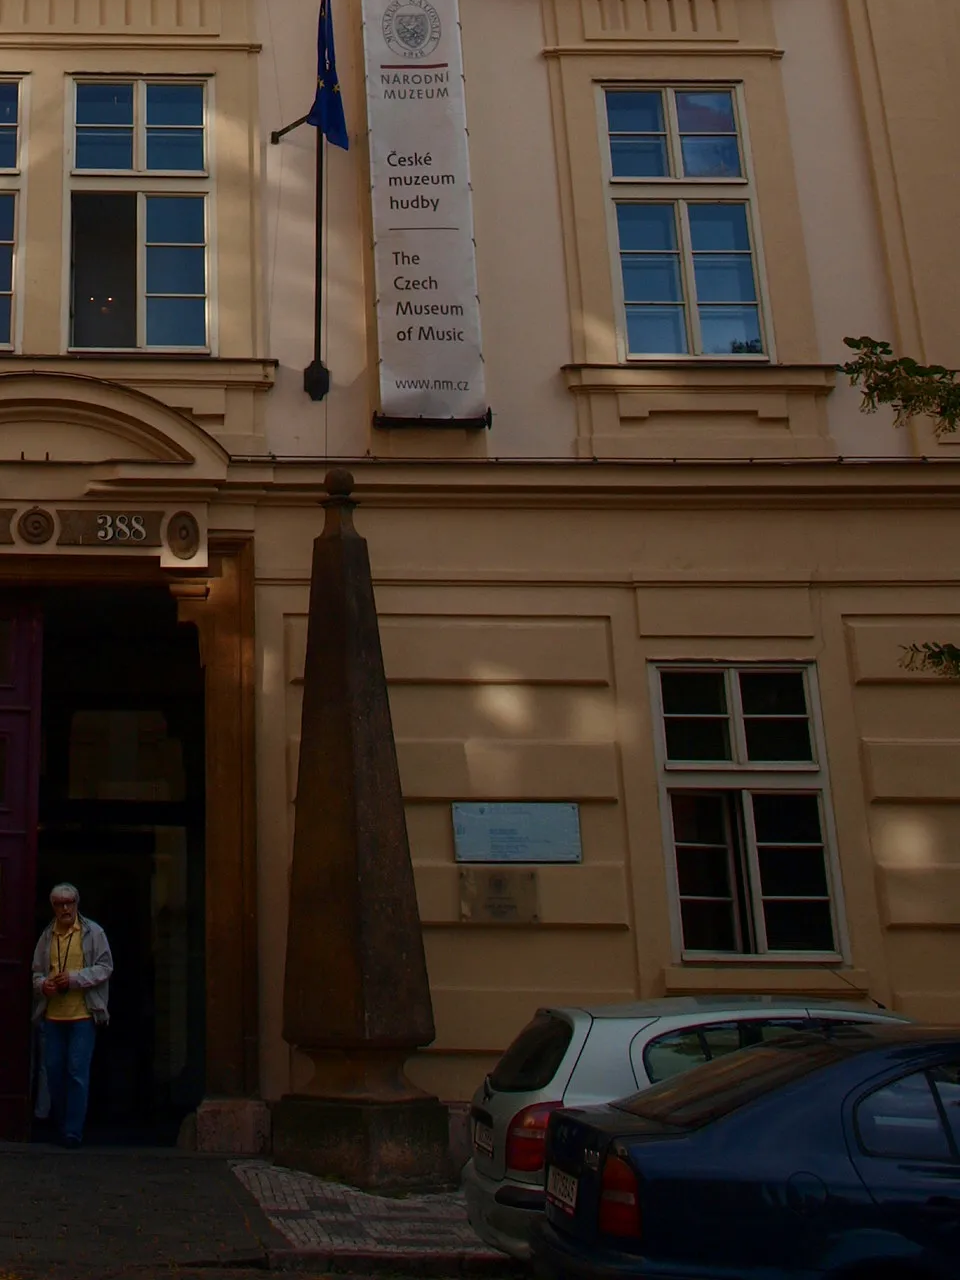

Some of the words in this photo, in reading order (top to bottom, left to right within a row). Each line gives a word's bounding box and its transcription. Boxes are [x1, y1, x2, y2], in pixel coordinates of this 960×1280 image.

[380, 71, 449, 86] NÁRODNÍ
[383, 87, 449, 100] MUZEUM
[386, 150, 433, 167] České
[388, 173, 455, 187] muzeum
[389, 195, 440, 212] hudby
[392, 251, 421, 266] The
[393, 276, 438, 291] Czech
[395, 301, 464, 316] Museum
[396, 326, 413, 342] of
[418, 326, 465, 342] Music
[395, 378, 470, 392] www.nm.cz
[96, 514, 148, 541] 388
